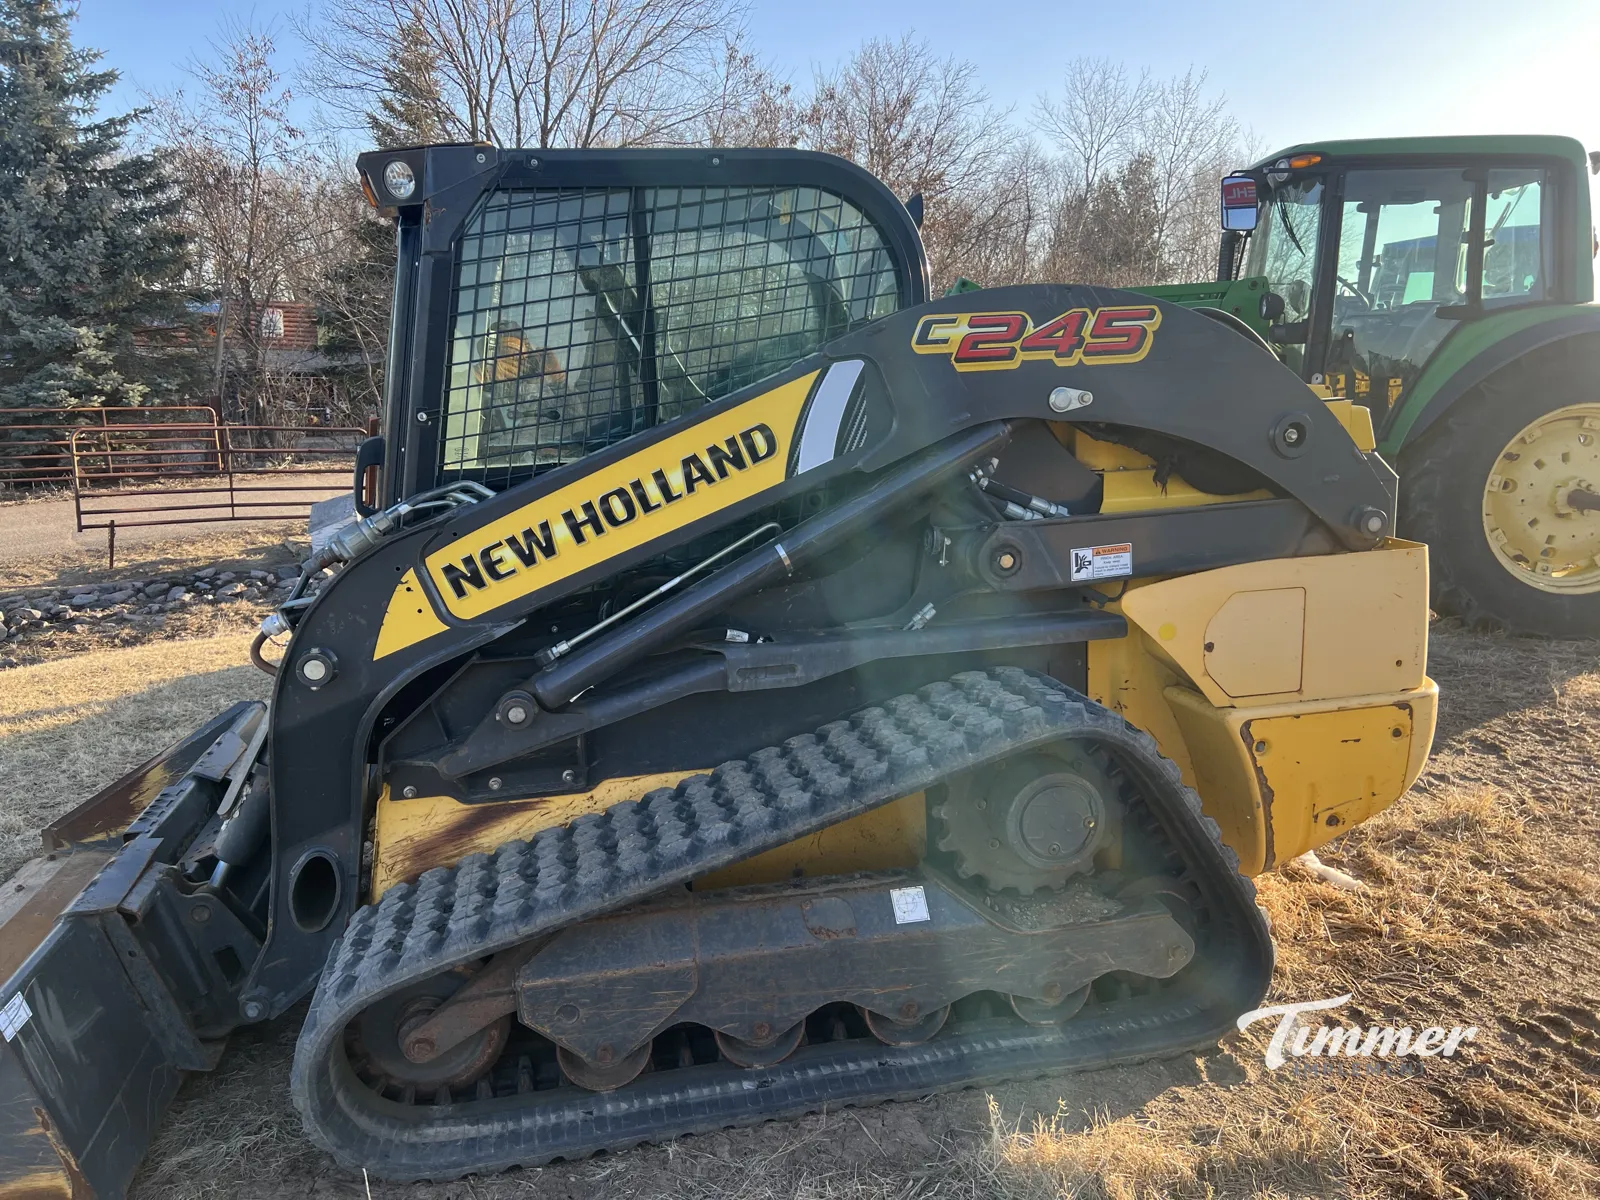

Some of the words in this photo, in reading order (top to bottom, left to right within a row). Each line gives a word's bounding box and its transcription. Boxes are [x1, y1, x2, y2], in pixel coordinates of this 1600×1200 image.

[911, 305, 1162, 372] C245
[440, 518, 558, 600] NEW
[560, 422, 778, 546] HOLLAND
[1101, 546, 1128, 554] WARNING
